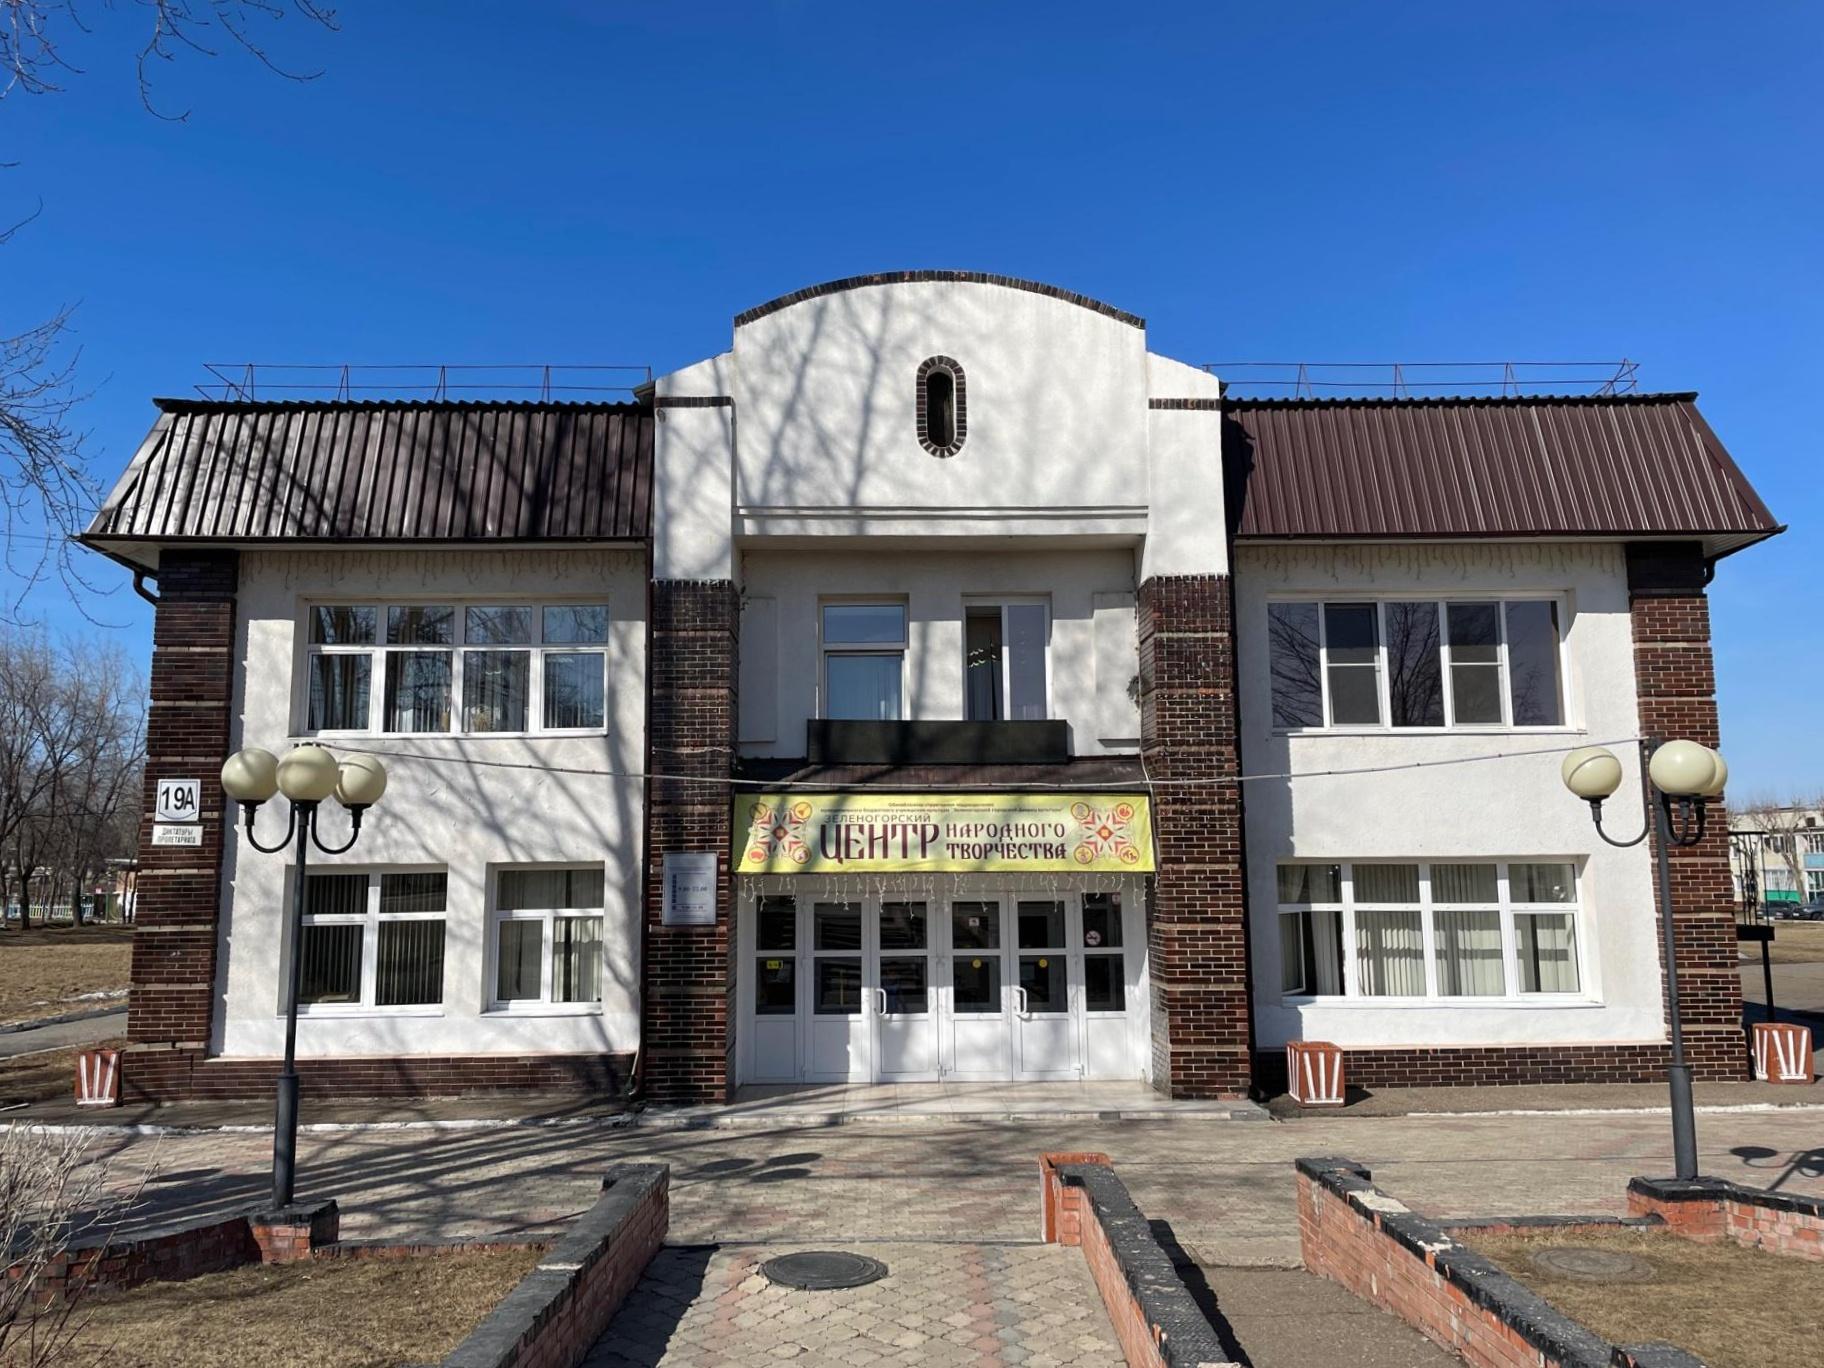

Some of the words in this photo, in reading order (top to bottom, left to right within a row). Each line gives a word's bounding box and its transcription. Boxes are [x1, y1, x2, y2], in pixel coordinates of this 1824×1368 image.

[824, 813, 931, 824] ЗЕЛЕНОГОРСКИЙ
[946, 823, 1065, 842] НАРОДНОГО
[820, 823, 940, 865] ЦЕНТР
[946, 842, 1067, 860] ТВОРЧЕСТВА
